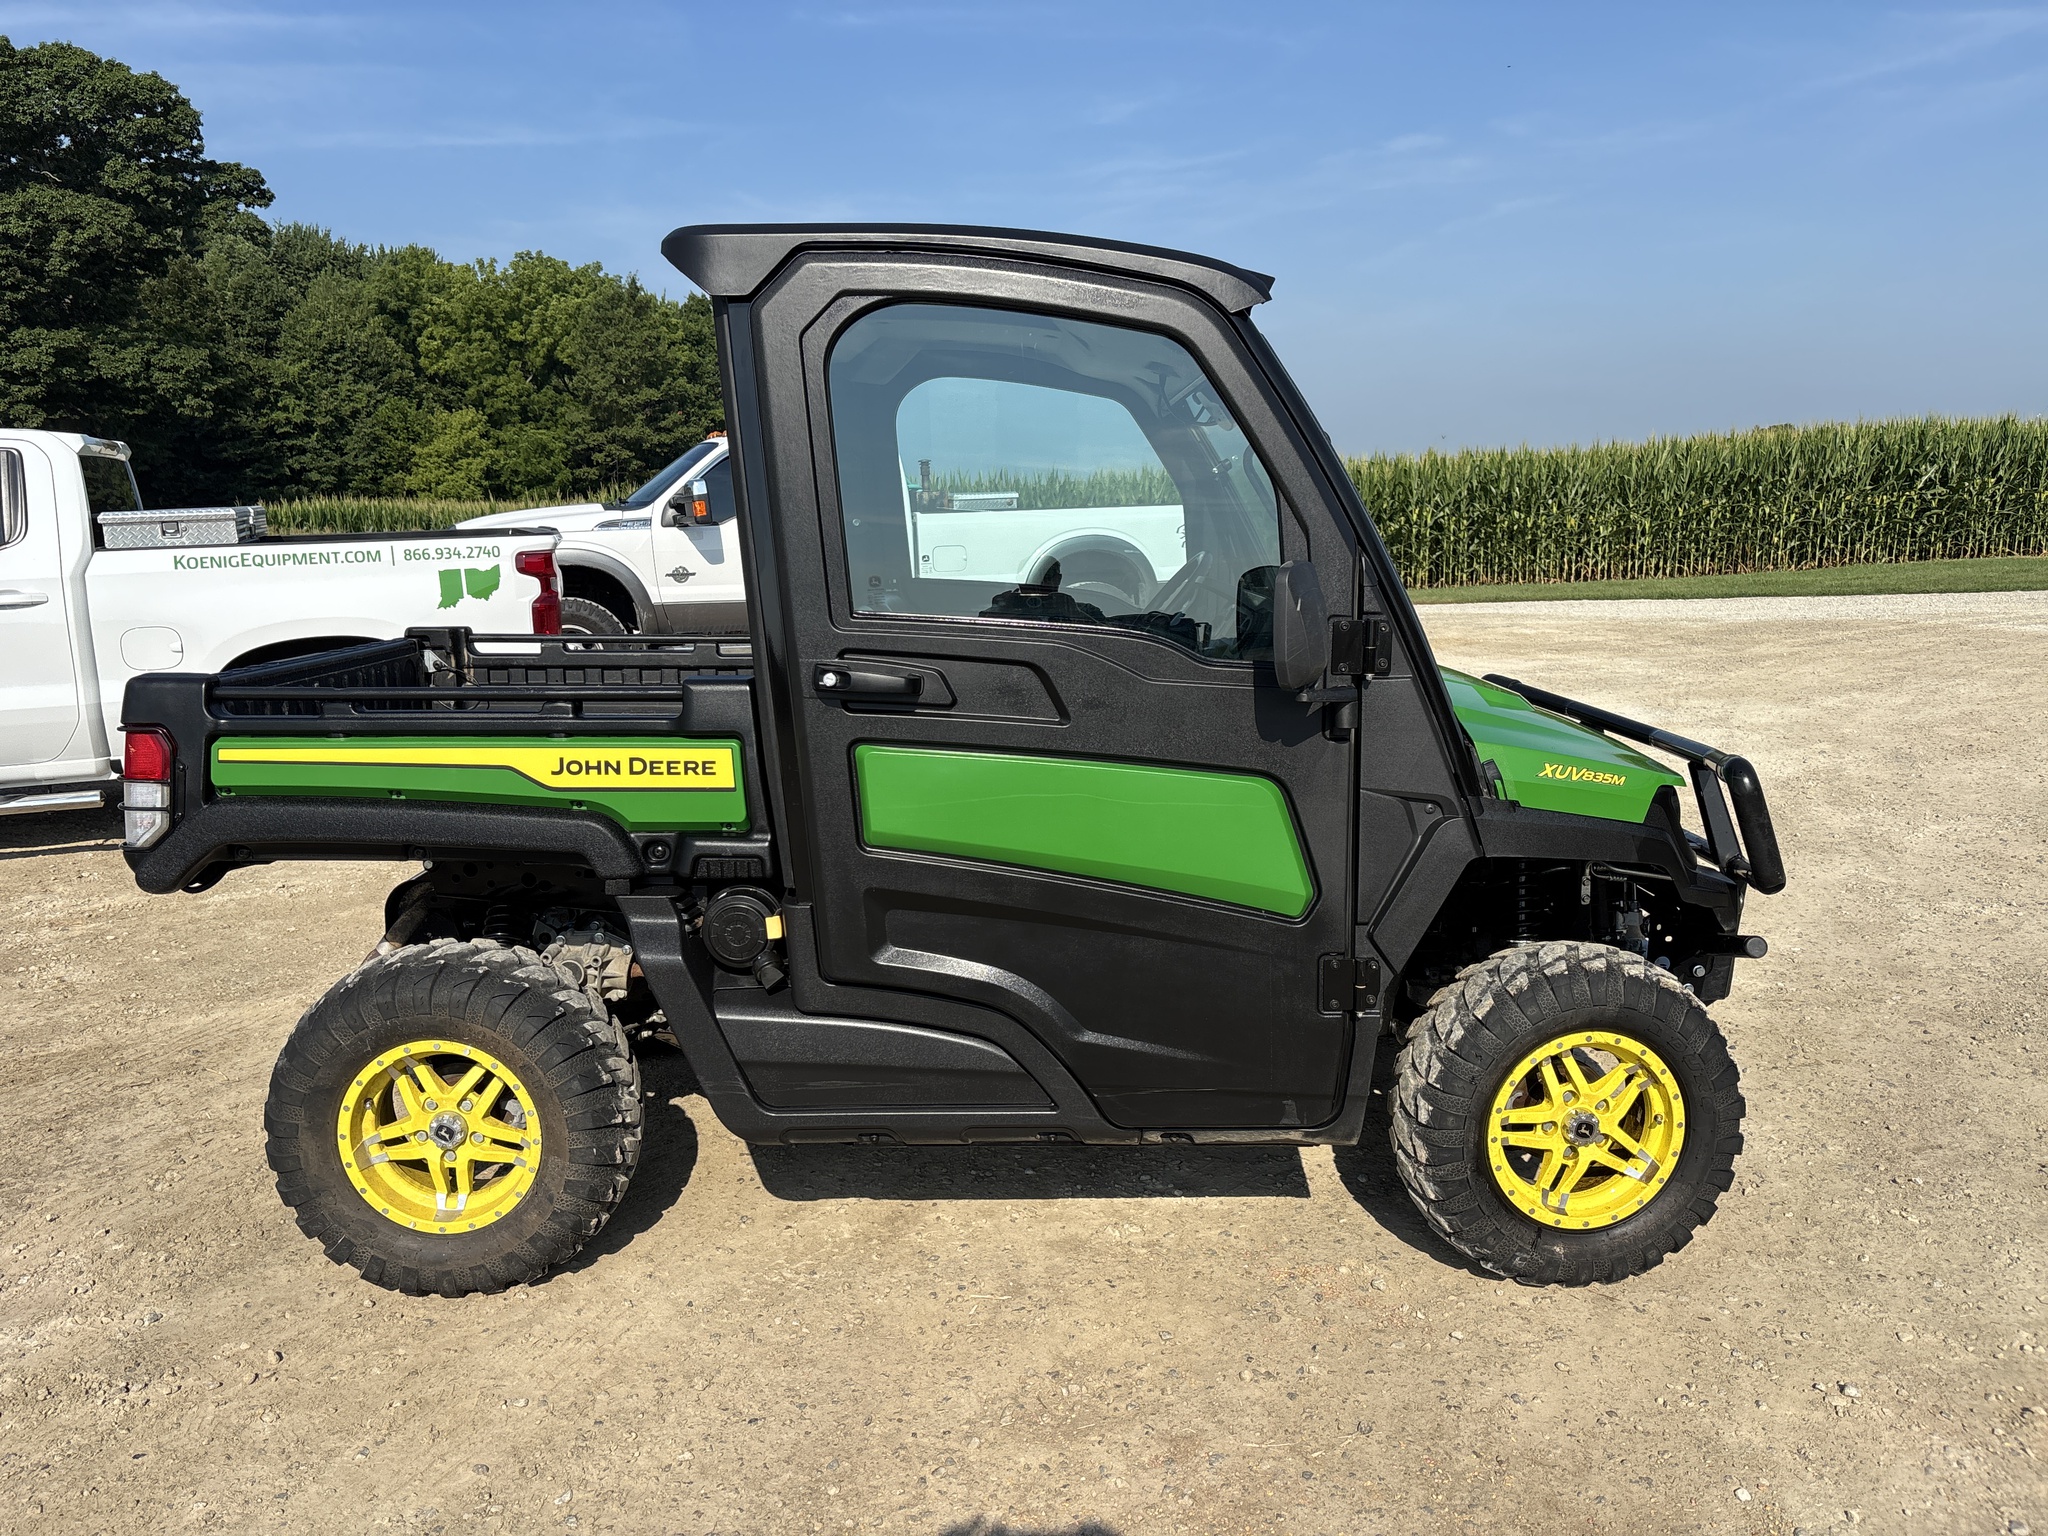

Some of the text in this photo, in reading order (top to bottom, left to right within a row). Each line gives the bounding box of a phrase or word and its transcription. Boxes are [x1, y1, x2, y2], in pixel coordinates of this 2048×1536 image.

[173, 545, 501, 570] KOENIGEQUIPMENT.COM 866.934.2740
[551, 756, 717, 776] JOHN DEERE
[1537, 762, 1627, 786] XUV835M
